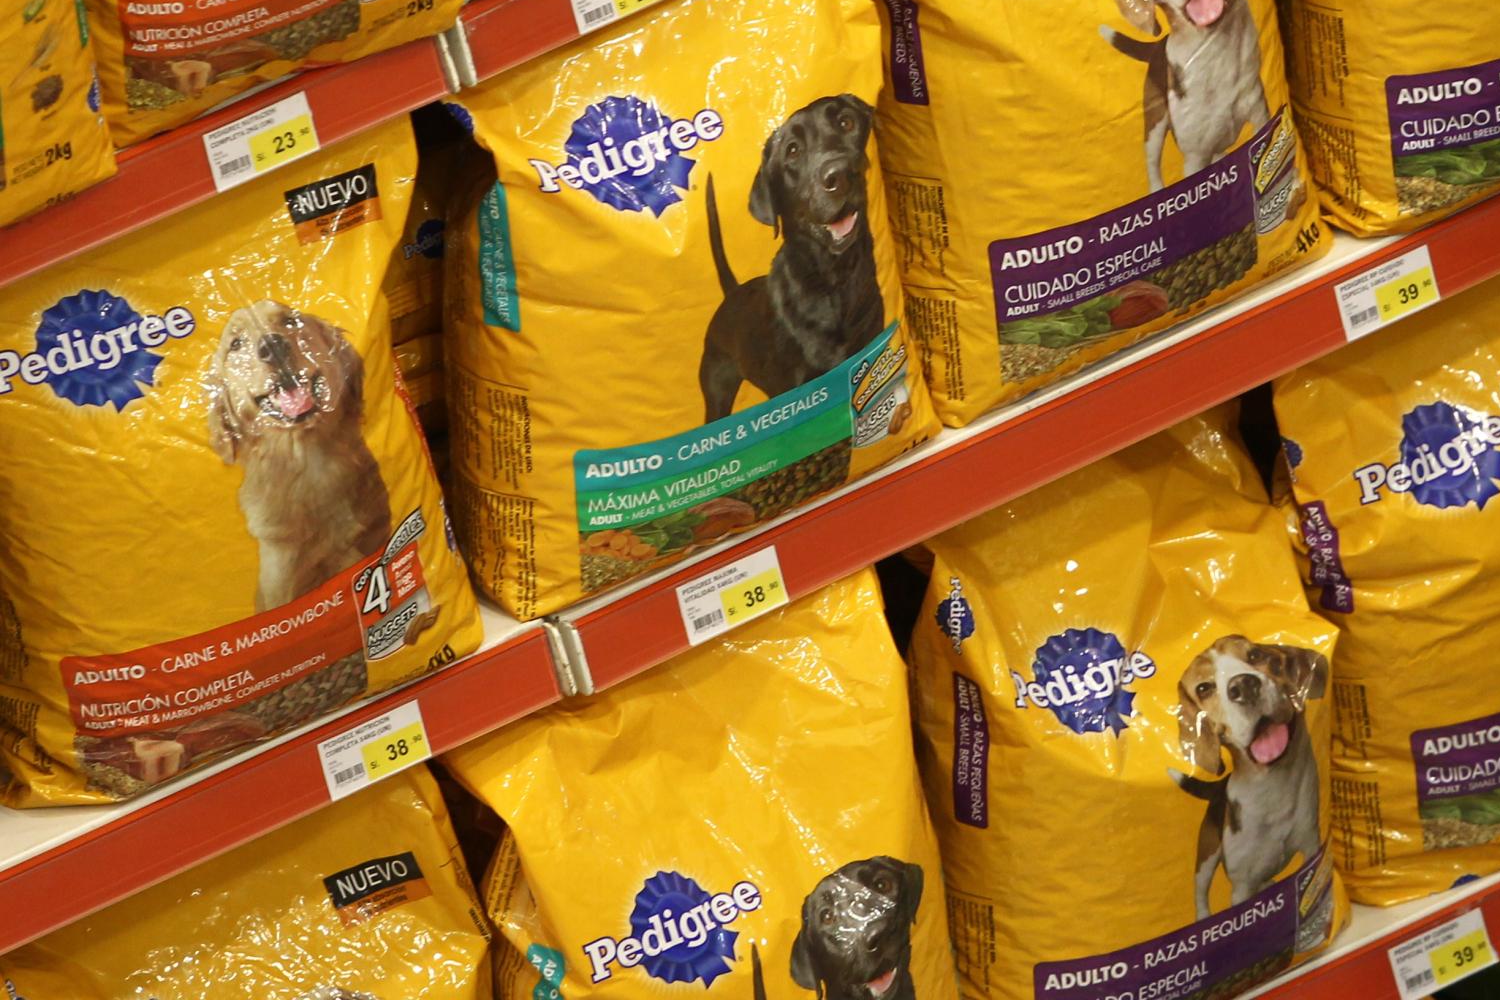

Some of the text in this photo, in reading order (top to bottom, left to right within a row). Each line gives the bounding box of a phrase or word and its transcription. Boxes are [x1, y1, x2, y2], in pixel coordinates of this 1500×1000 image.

[128, 5, 270, 42] NUTRICIÓN COMPLETA
[1397, 78, 1482, 105] ADULTO
[272, 131, 296, 154] 23
[1400, 109, 1490, 138] CUIDADO
[1402, 138, 1435, 151] ADULT
[1443, 132, 1472, 146] SMALL
[45, 140, 73, 166] 2kg
[529, 108, 724, 194] Pedigree
[296, 174, 368, 214] NUEVO
[1000, 165, 1239, 271] ADULTO RAZAS PEQUEÑAS
[1004, 237, 1167, 304] CUIDADO ESPECIAL
[1007, 303, 1039, 317] ADULT
[1047, 294, 1074, 309] SMALL
[1108, 267, 1139, 286] SPECIAL
[1140, 256, 1162, 272] CARE
[1398, 284, 1420, 304] 39
[0, 306, 195, 393] Pedigree
[853, 362, 869, 384] con
[585, 387, 829, 479] ADULTO CARNE VEGETALES
[588, 459, 742, 513] MÁXIMA VITALIDAD
[589, 513, 623, 526] ADULT
[631, 506, 656, 520] MEAT
[721, 474, 745, 488] TOTAL
[746, 458, 778, 479] VITALITY
[355, 568, 372, 591] con
[363, 566, 391, 613] 4
[744, 586, 766, 607] 38
[73, 590, 345, 686] ADULTO CARNE MARROWBONE
[80, 669, 255, 719] NUTRICIÓN COMPLETA
[124, 715, 151, 728] MEAT
[236, 674, 279, 699] COMPLETE
[281, 652, 326, 680] NUTRITION
[1013, 647, 1156, 710] Pedigree
[386, 740, 409, 761] 38
[971, 730, 983, 822] RAZAS PEQUEÑAS
[336, 860, 409, 898] NUEVO
[584, 880, 762, 984] Pedigree
[1045, 893, 1285, 991] ADULTO RAZAS PEQUEÑAS
[1140, 962, 1209, 998] ESPECIAL
[1453, 947, 1474, 967] 39
